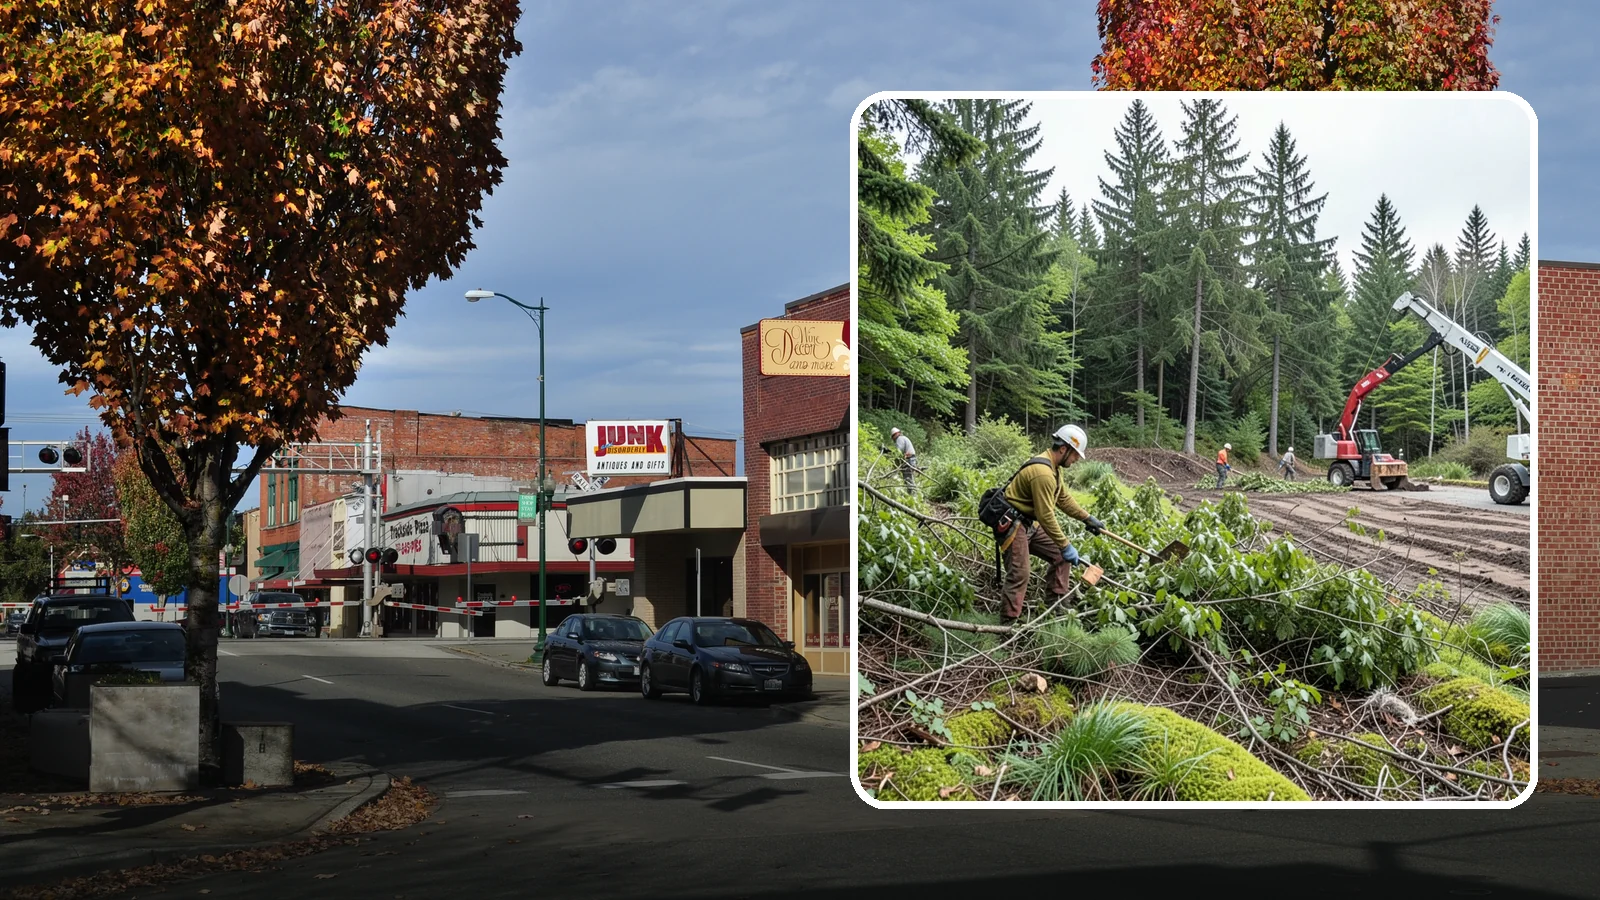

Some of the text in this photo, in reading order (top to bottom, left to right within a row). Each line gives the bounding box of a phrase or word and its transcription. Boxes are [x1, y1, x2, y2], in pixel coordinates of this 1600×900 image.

[595, 425, 665, 457] JUNK
[607, 446, 646, 454] DISORDERLY
[597, 460, 665, 470] ANTIQUES AND GIFTS
[415, 519, 429, 535] Pizza
